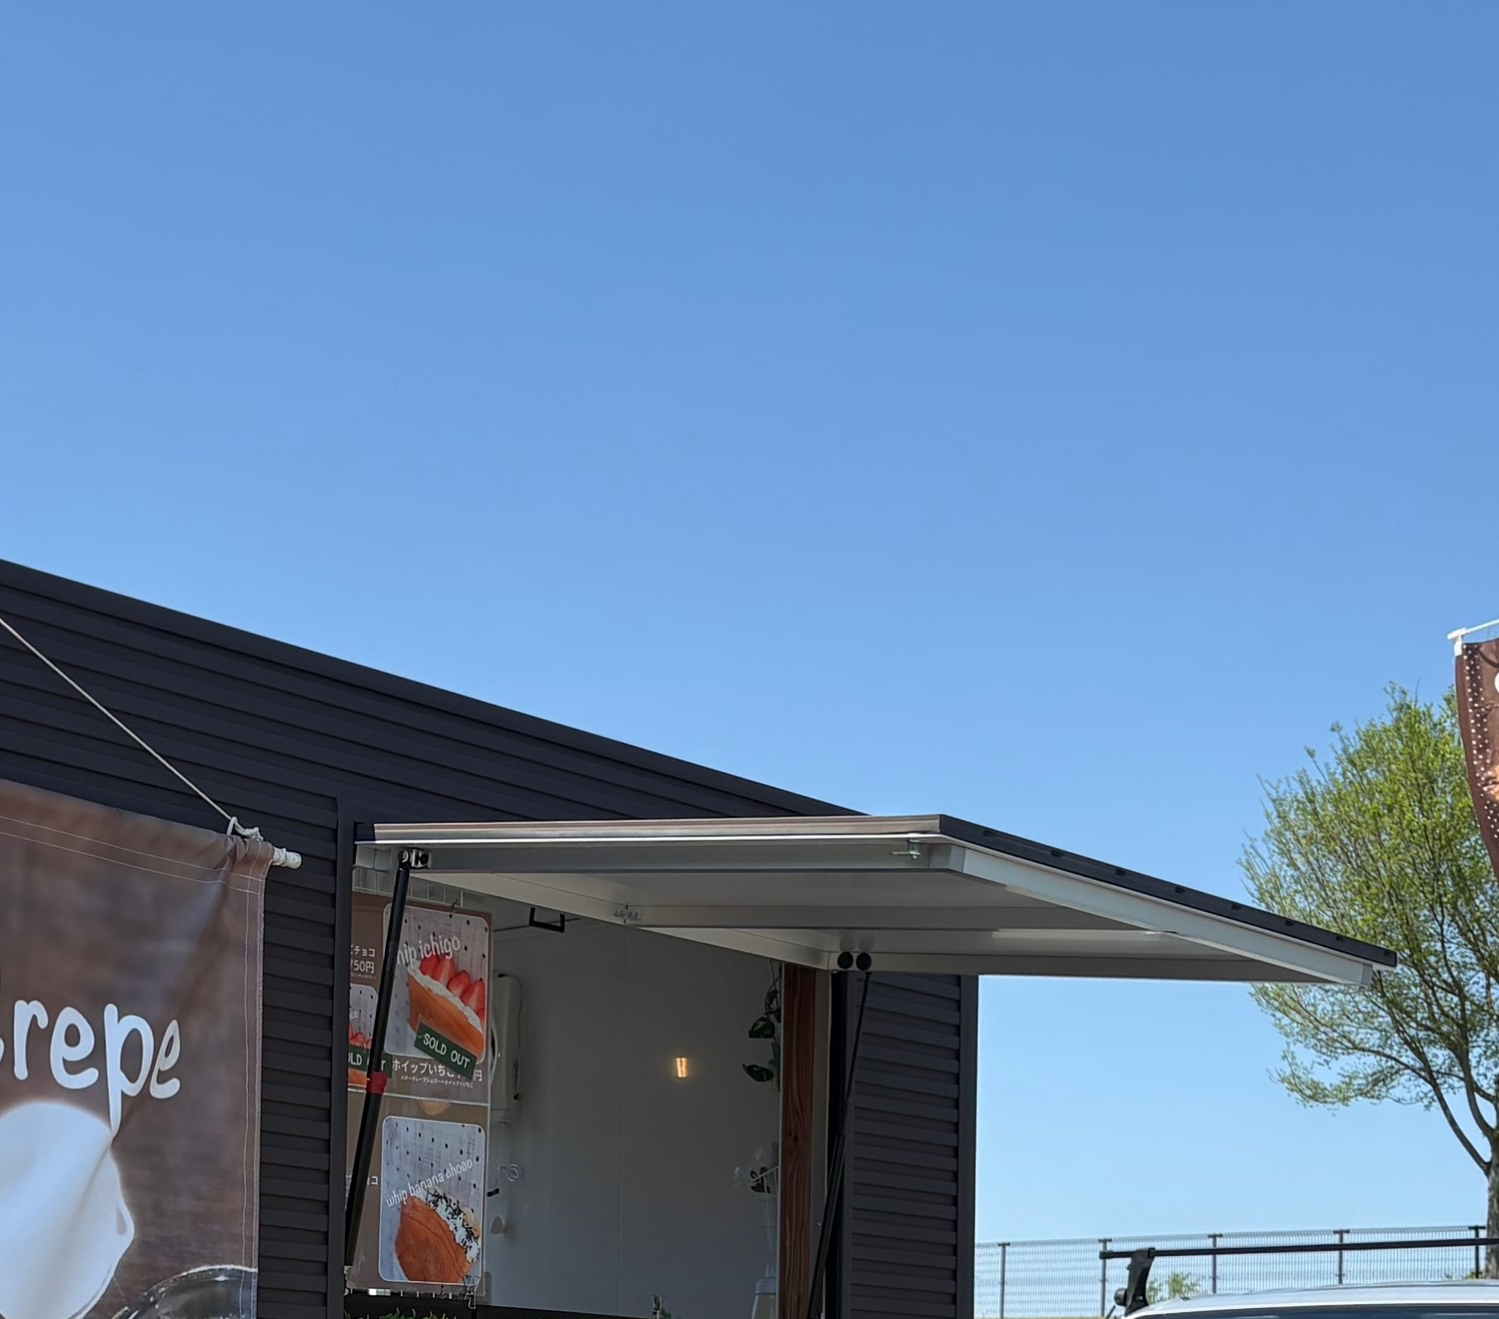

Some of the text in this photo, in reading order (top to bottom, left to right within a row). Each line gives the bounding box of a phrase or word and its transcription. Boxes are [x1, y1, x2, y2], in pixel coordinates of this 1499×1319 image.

[419, 934, 461, 960] ichigo
[422, 1033, 471, 1069] SOLD OUT
[386, 1189, 408, 1207] whip
[408, 1172, 445, 1196] banana
